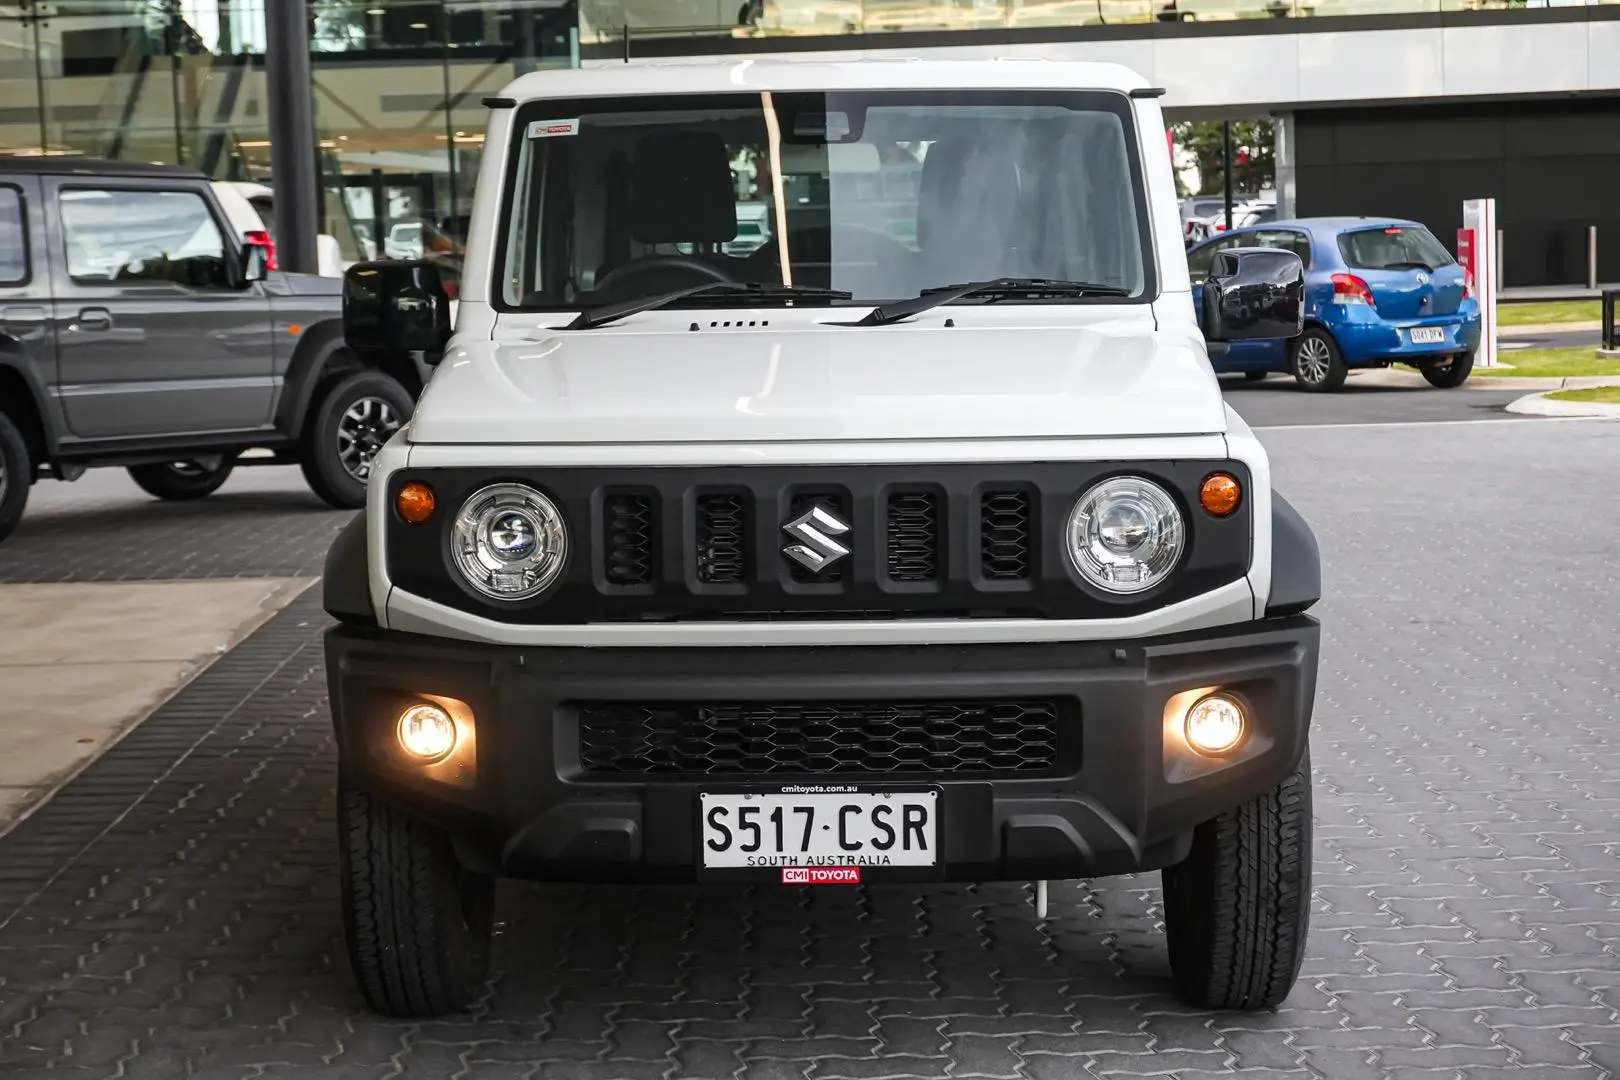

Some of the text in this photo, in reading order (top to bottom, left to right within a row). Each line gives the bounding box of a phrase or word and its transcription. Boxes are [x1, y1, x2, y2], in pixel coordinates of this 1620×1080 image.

[781, 784, 858, 794] cmitoyota.com.au
[747, 855, 891, 866] SOUTH AUSTRALIA
[785, 870, 859, 881] CMI TOYOTA
